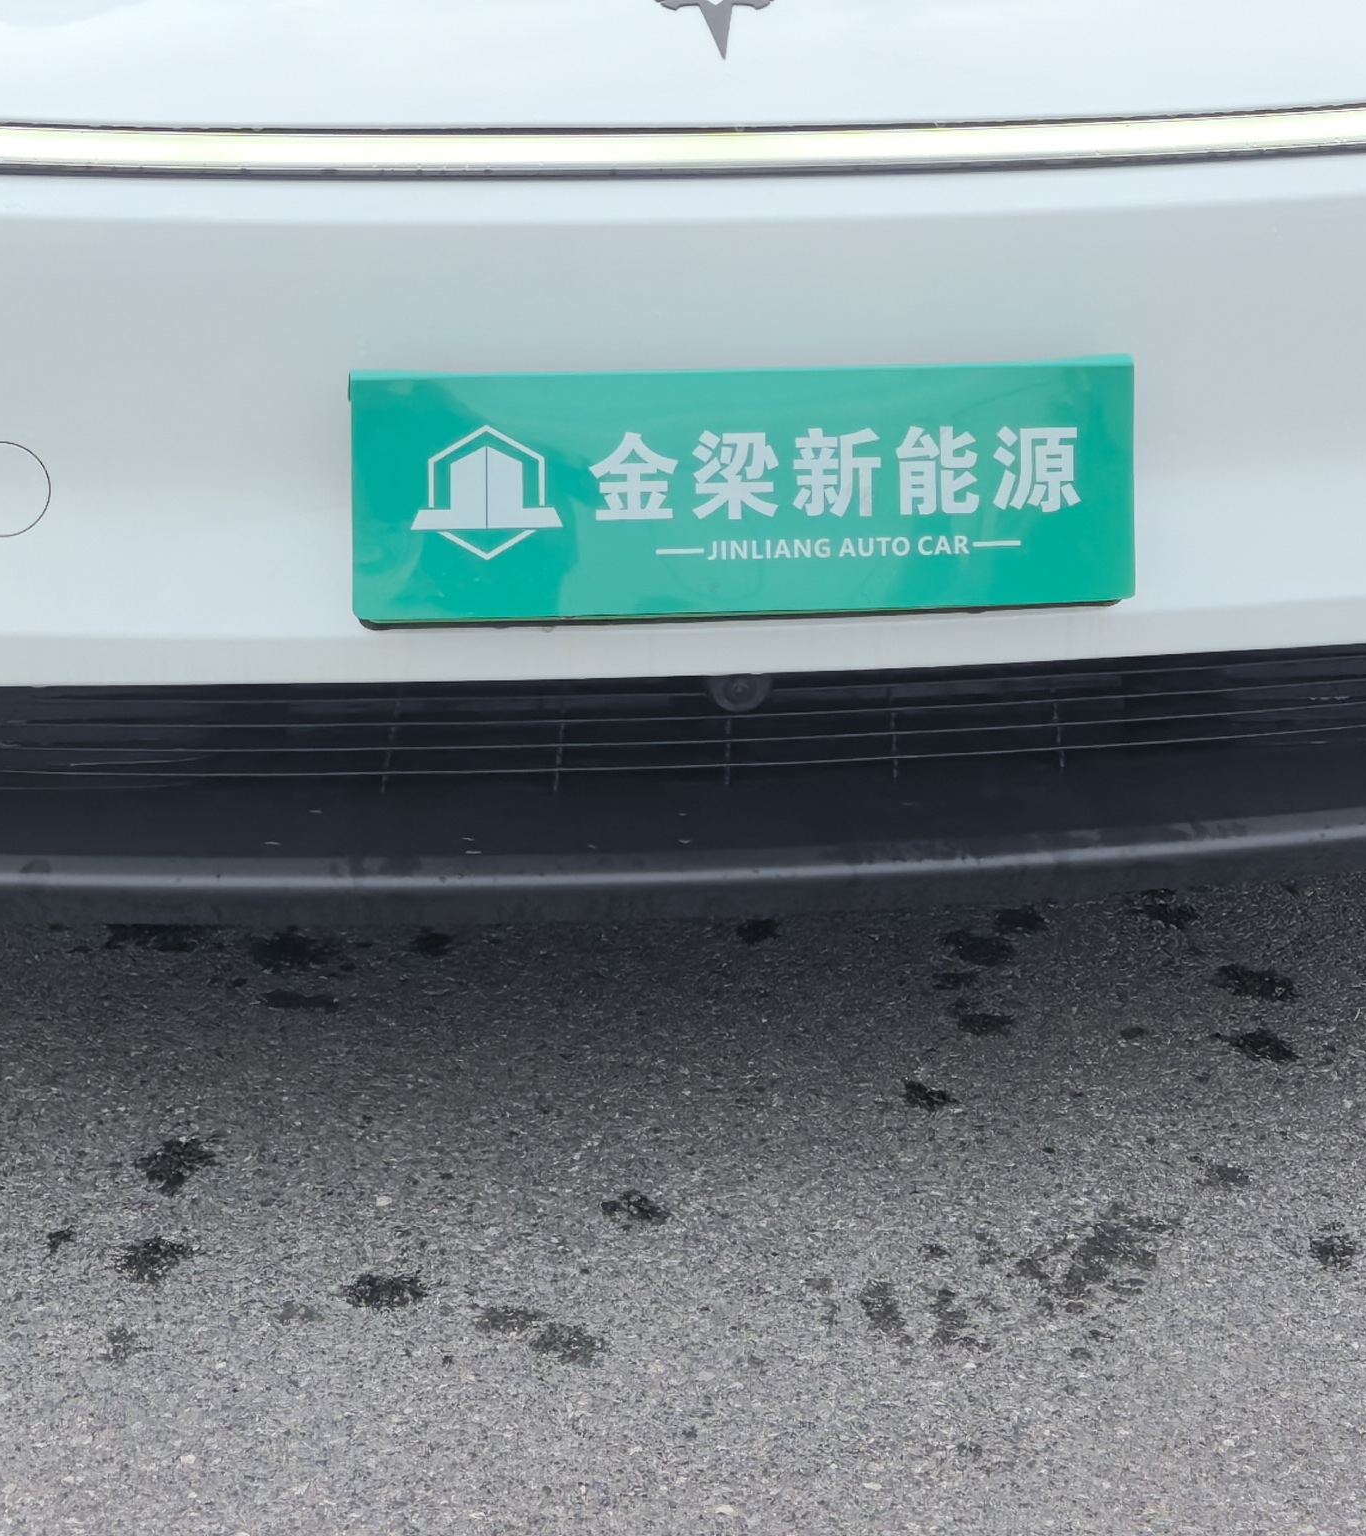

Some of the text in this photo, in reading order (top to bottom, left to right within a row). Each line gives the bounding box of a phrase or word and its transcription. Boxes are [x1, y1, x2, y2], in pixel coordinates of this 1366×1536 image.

[589, 425, 1081, 521] 金梁新能源
[707, 534, 970, 560] JINLIANG AUTO CAR
